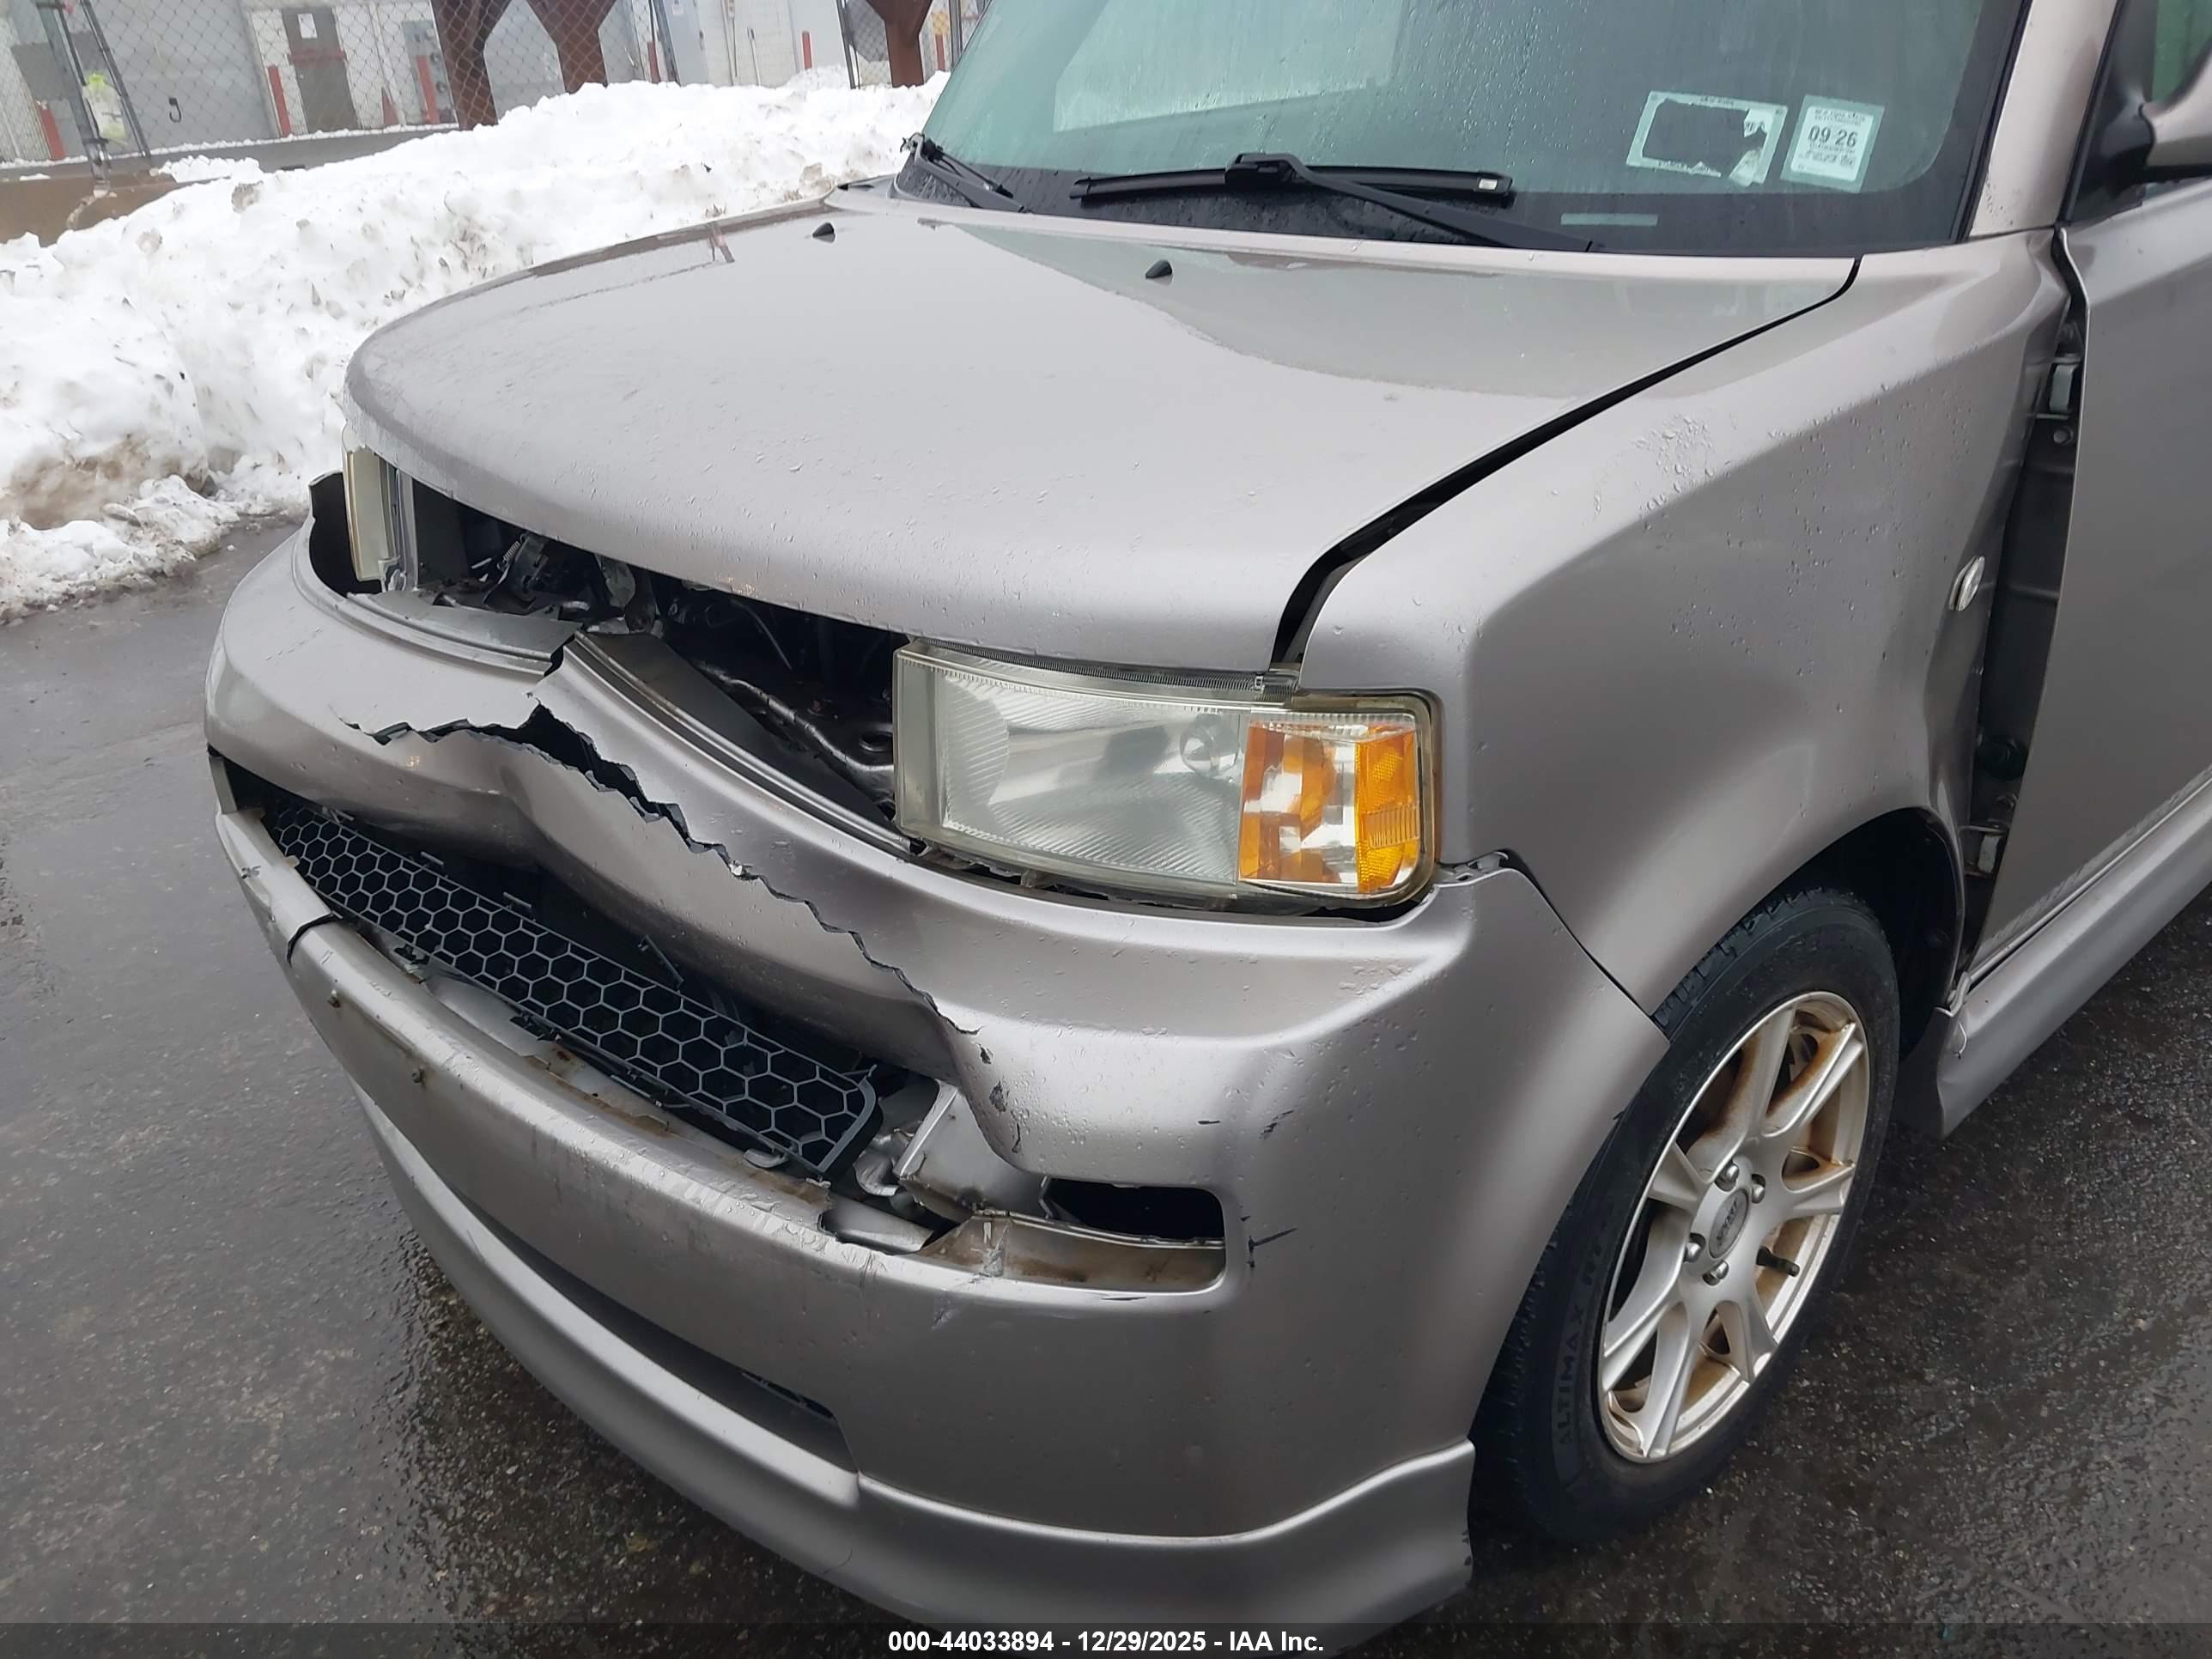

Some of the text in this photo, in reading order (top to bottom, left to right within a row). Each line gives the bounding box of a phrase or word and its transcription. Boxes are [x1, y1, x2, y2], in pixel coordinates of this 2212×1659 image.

[1808, 125, 1857, 148] 09 26
[1558, 1304, 1586, 1448] ALTIMAX
